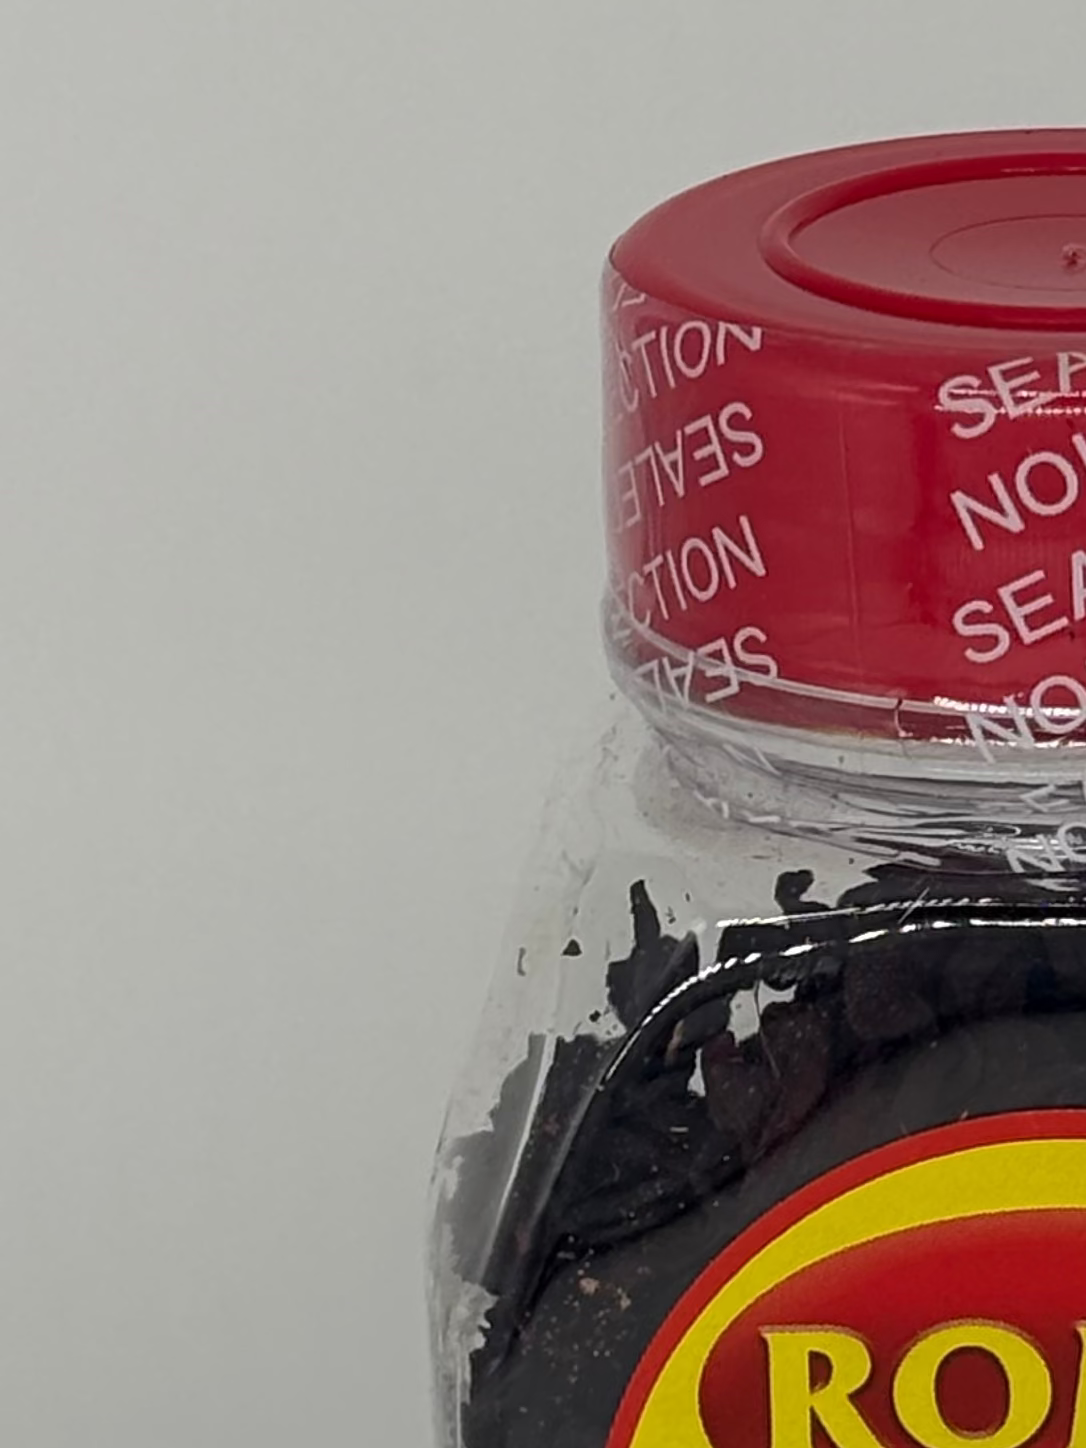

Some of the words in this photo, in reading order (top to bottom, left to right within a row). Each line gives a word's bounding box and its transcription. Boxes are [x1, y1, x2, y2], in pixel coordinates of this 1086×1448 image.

[616, 401, 764, 531] SEALE
[626, 514, 767, 628] CTION
[630, 626, 779, 713] SEAL
